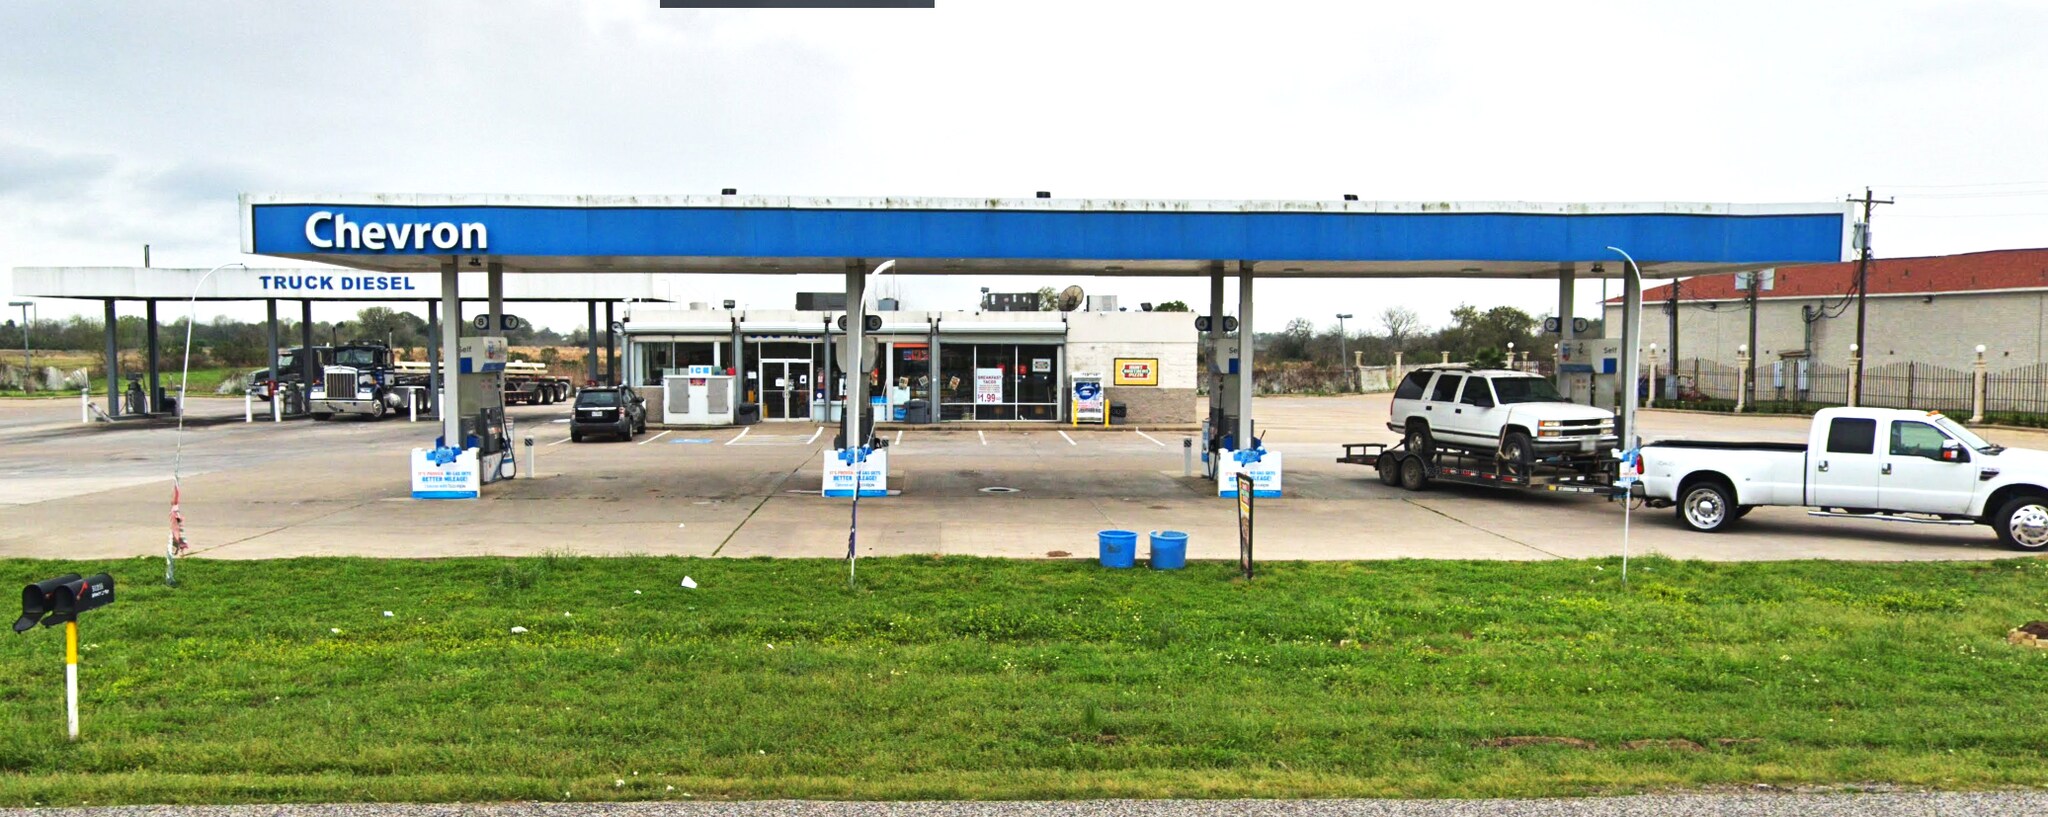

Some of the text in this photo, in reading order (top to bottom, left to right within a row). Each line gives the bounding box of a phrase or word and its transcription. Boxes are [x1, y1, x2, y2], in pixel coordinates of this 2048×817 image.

[305, 211, 488, 250] Chevron
[259, 275, 415, 290] TRUCK DIESEL
[977, 393, 996, 402] $1.99
